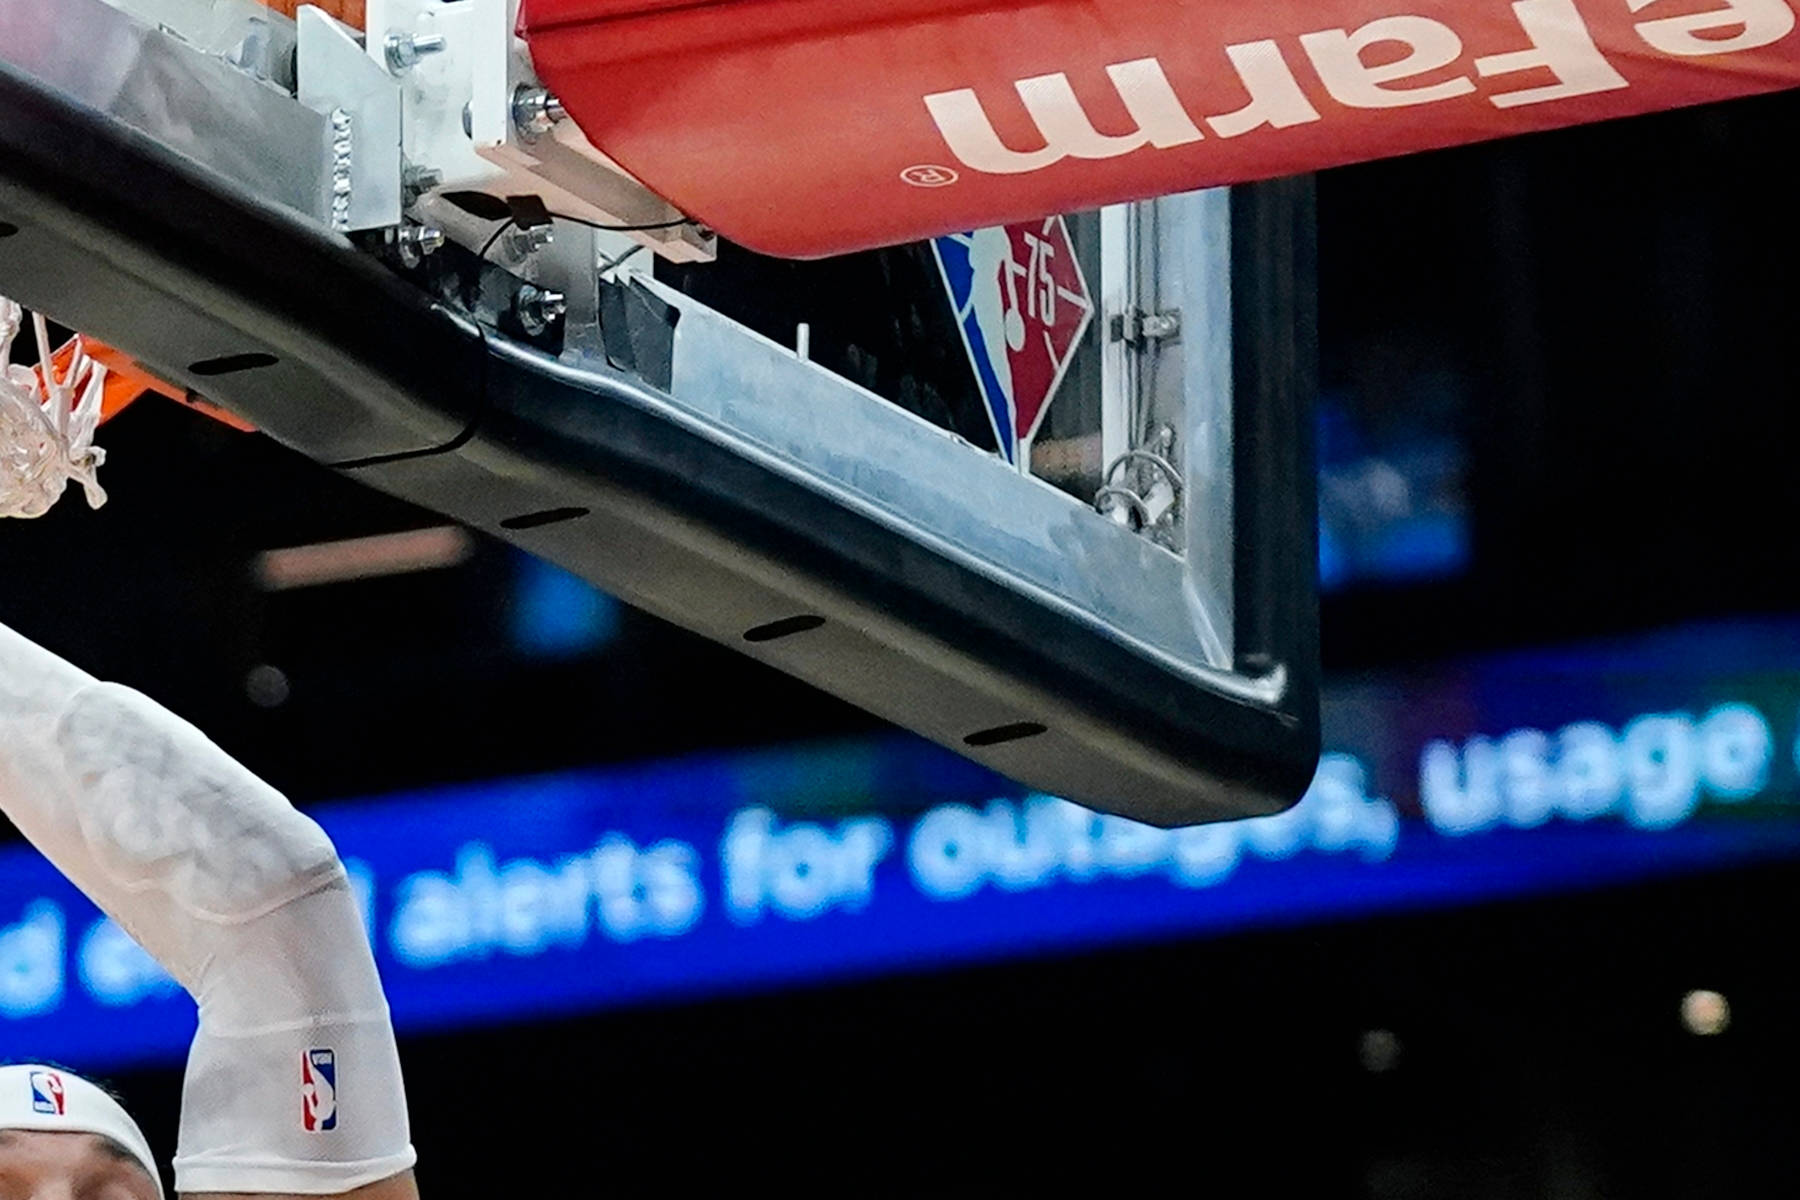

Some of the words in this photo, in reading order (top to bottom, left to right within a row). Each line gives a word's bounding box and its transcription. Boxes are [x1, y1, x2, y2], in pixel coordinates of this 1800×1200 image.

[1023, 230, 1055, 327] 75
[393, 838, 703, 966] alerts
[720, 804, 886, 914] for
[1419, 703, 1773, 834] usage
